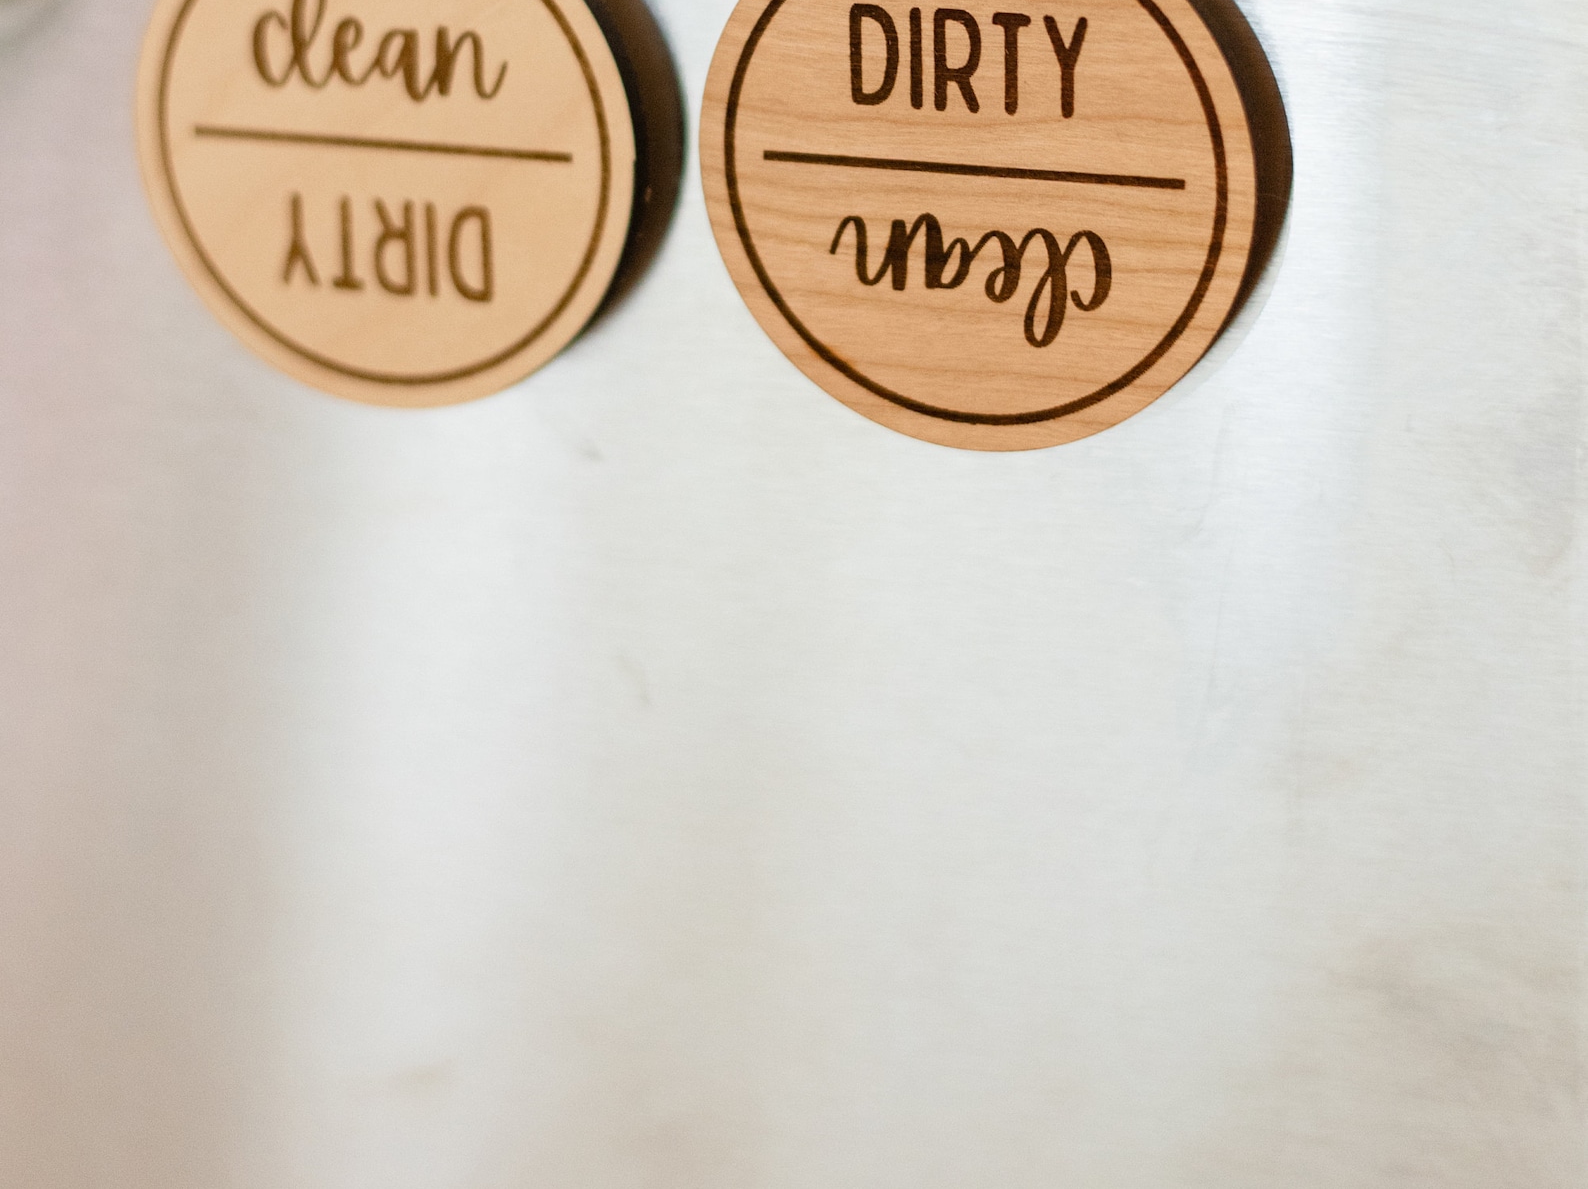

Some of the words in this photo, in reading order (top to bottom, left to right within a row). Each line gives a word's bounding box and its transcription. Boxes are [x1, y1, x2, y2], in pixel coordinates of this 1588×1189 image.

[848, 2, 1089, 119] DIRTY
[282, 191, 495, 304] DIRTY
[828, 212, 1113, 349] clean
